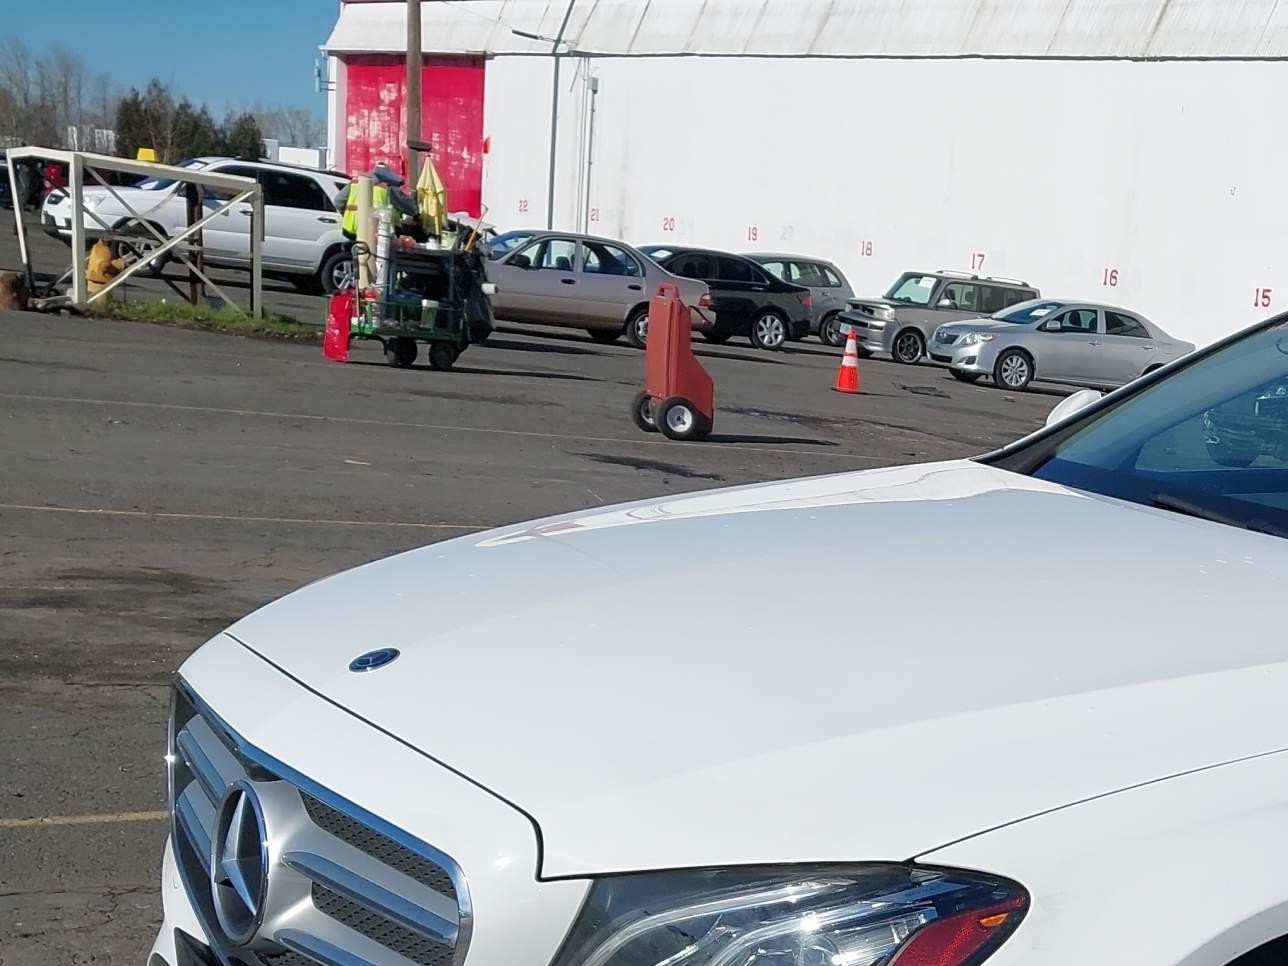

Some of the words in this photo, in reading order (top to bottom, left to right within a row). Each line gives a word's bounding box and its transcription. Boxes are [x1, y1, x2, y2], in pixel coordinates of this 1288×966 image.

[662, 217, 675, 231] 20
[748, 225, 758, 241] 19
[861, 240, 873, 256] 18
[971, 252, 985, 270] 17
[1102, 268, 1119, 287] 16
[1253, 287, 1272, 307] 15
